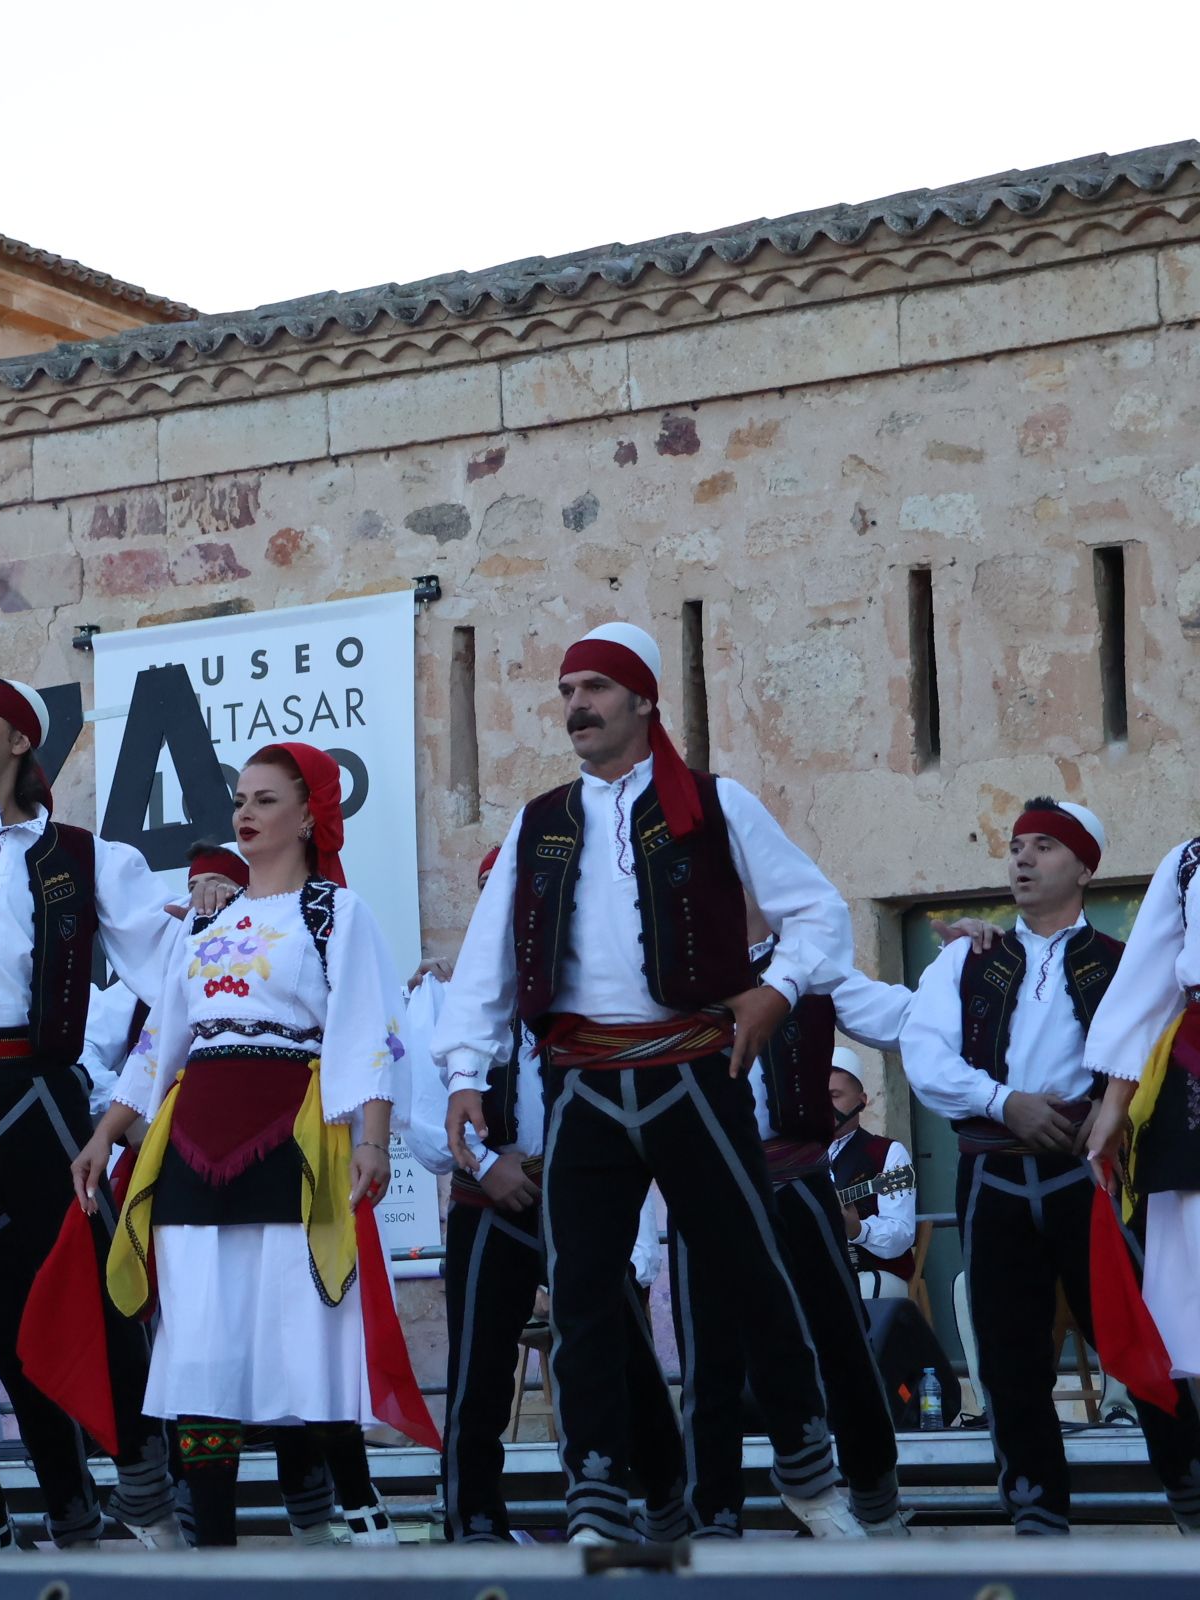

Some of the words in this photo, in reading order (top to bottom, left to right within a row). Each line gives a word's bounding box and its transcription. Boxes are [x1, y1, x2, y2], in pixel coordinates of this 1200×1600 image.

[149, 636, 364, 688] USEO
[202, 687, 366, 745] LTASAR
[389, 1152, 413, 1160] AMORA
[384, 1212, 415, 1223] SSION
